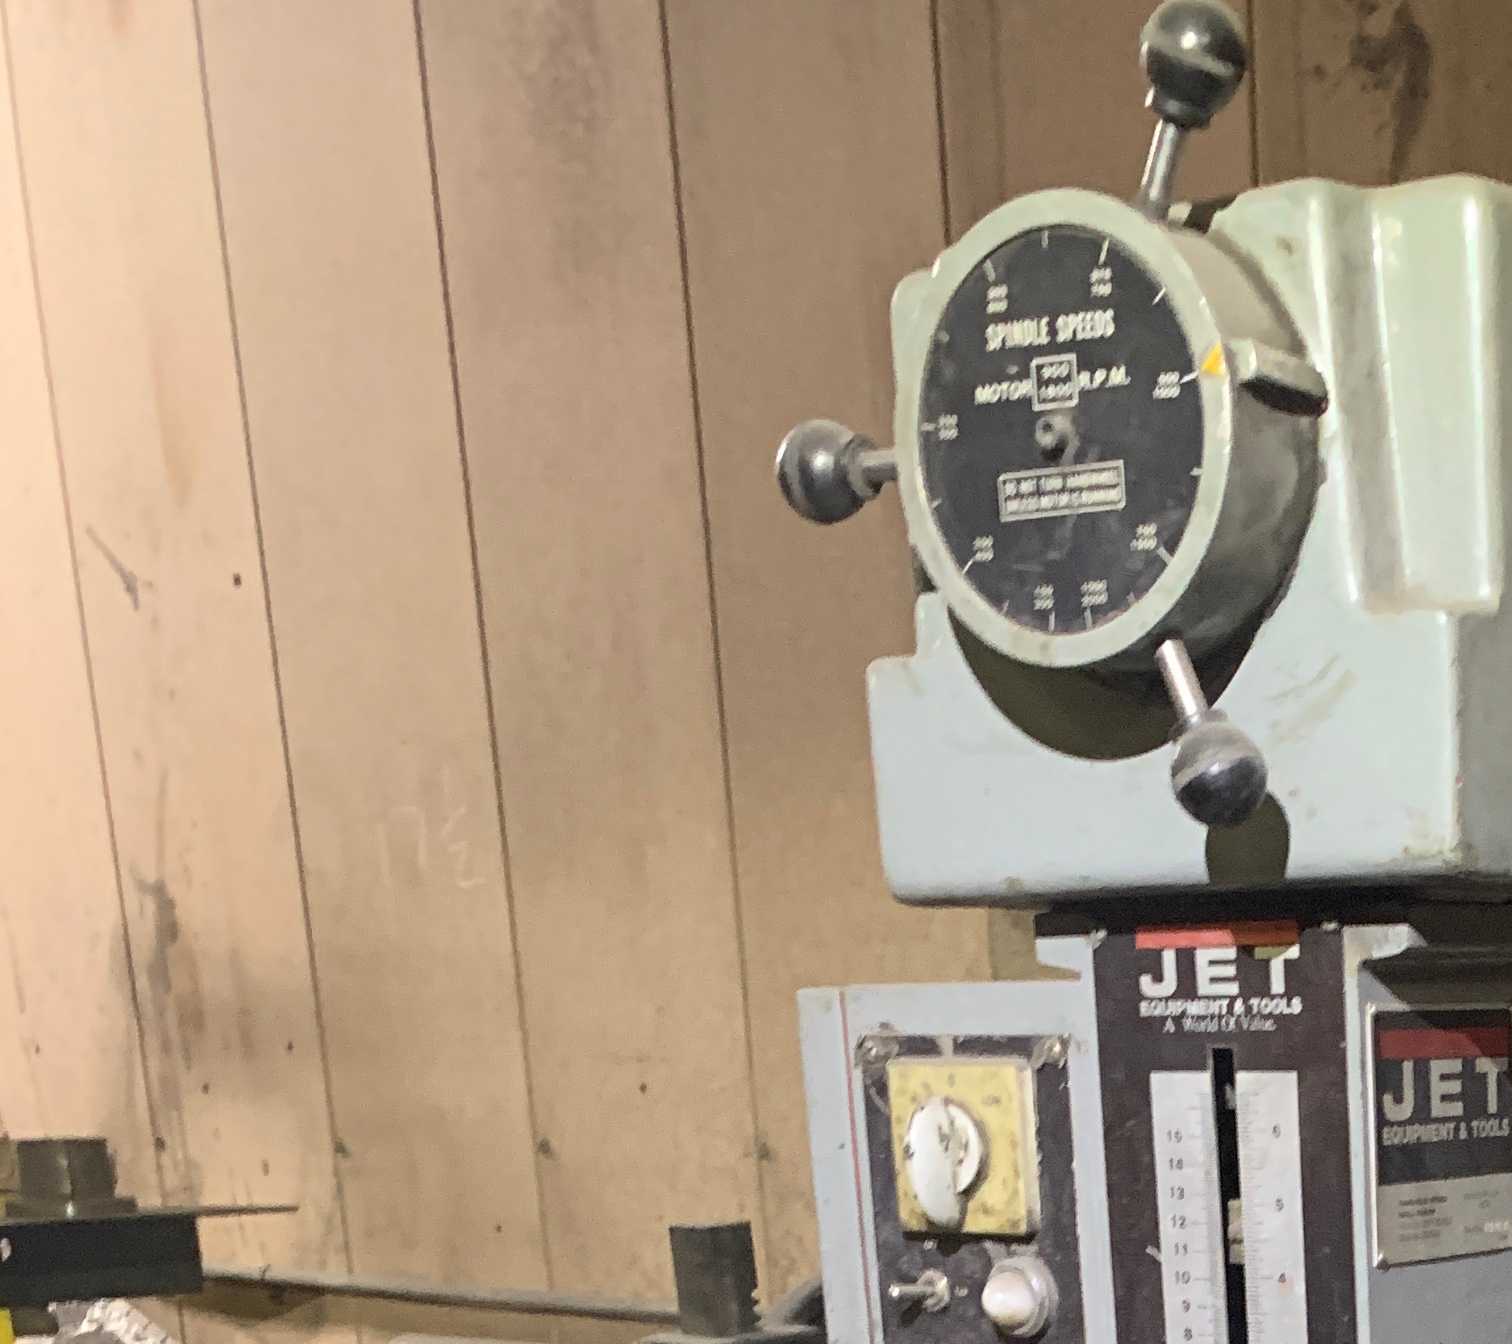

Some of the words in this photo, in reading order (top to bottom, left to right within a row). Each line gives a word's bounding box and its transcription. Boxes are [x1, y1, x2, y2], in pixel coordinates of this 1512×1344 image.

[985, 316, 1051, 352] SPINDLE
[1056, 308, 1115, 343] SPEEDS
[974, 379, 1033, 405] MOTOR
[1138, 944, 1301, 998] JET
[1139, 998, 1229, 1017] EQUIPMENT
[1233, 997, 1245, 1015] &
[1249, 996, 1303, 1015] TOOLS
[1381, 1057, 1510, 1121] JET
[1382, 1122, 1456, 1145] EQUIPMENT
[1458, 1120, 1469, 1140] &
[1471, 1117, 1511, 1139] TOOLS
